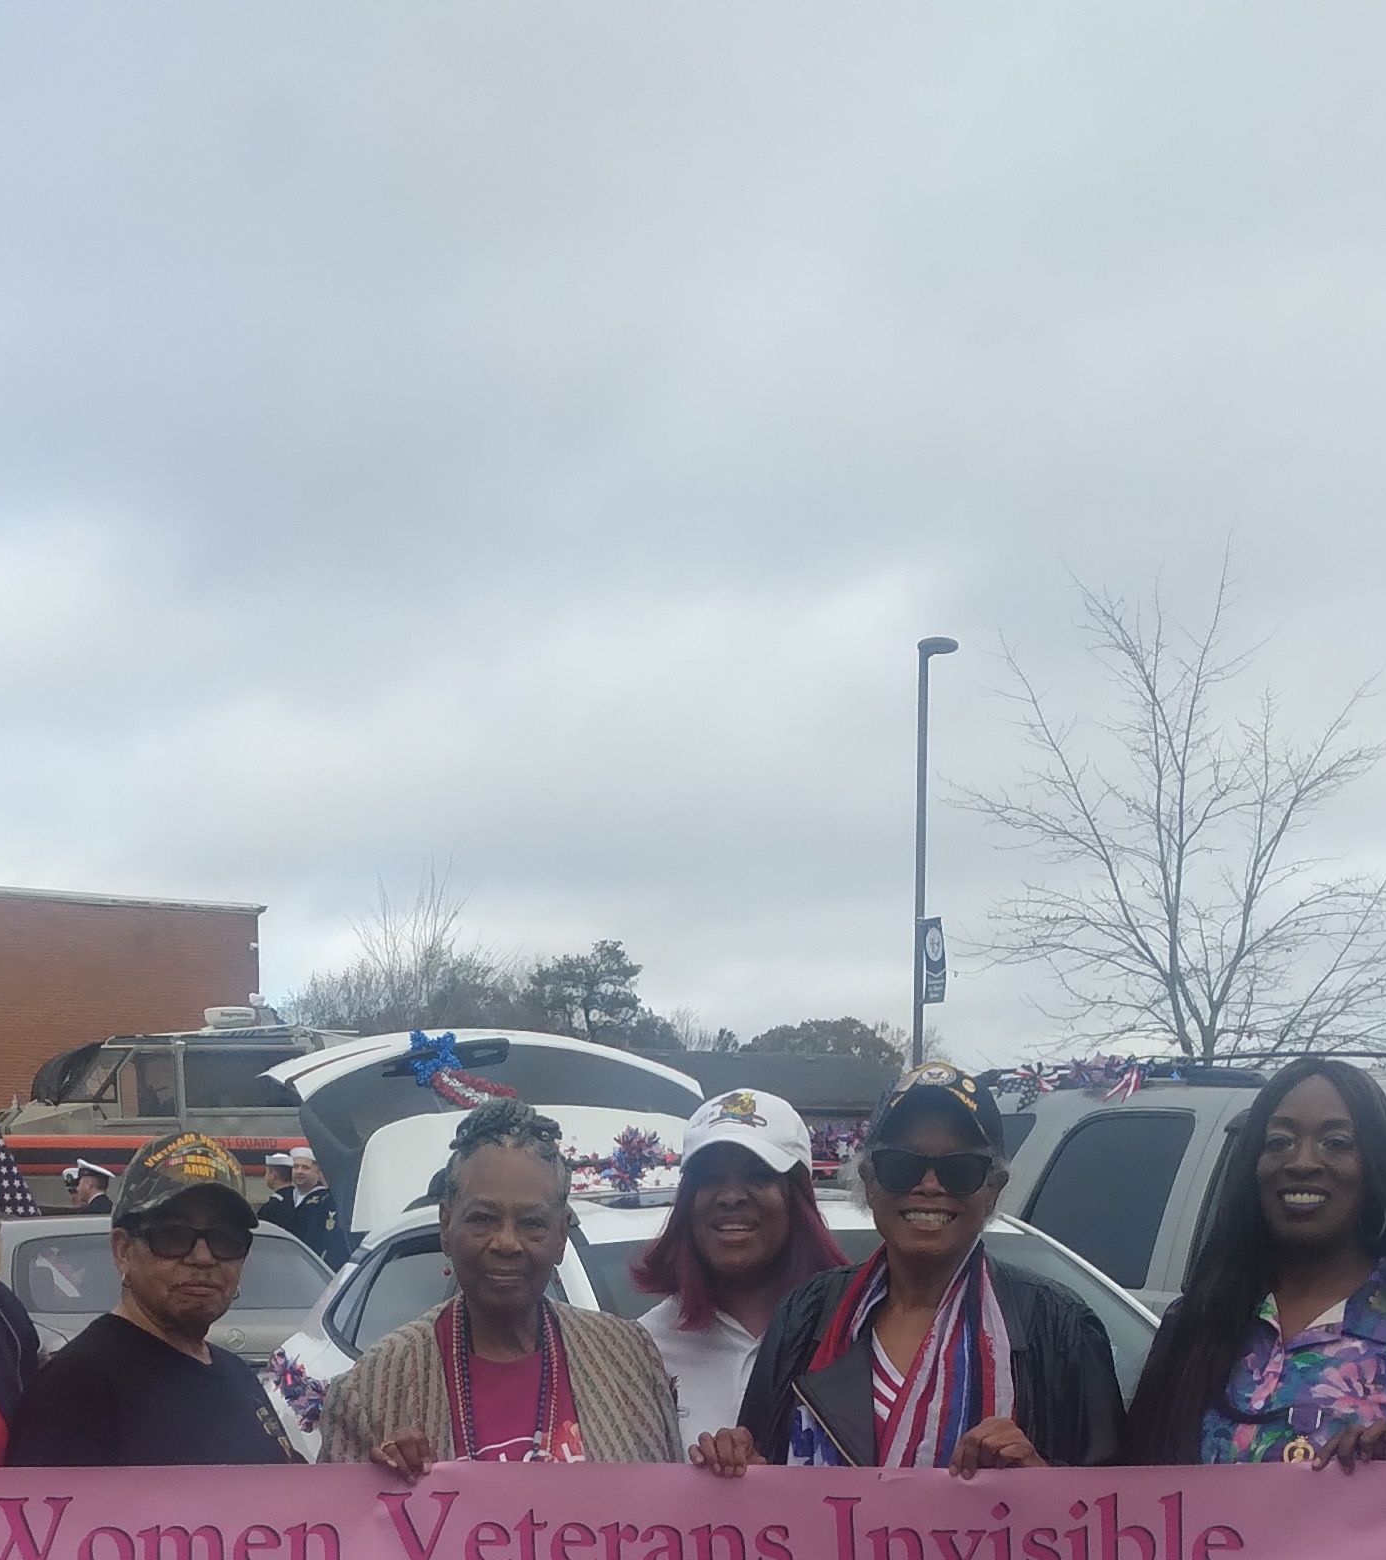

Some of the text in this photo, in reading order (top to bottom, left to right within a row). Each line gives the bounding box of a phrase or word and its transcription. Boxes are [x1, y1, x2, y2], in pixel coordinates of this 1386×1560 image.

[236, 1136, 278, 1149] GUARD
[143, 1133, 242, 1176] VIETNAM VETERAN
[184, 1163, 216, 1178] ARMY
